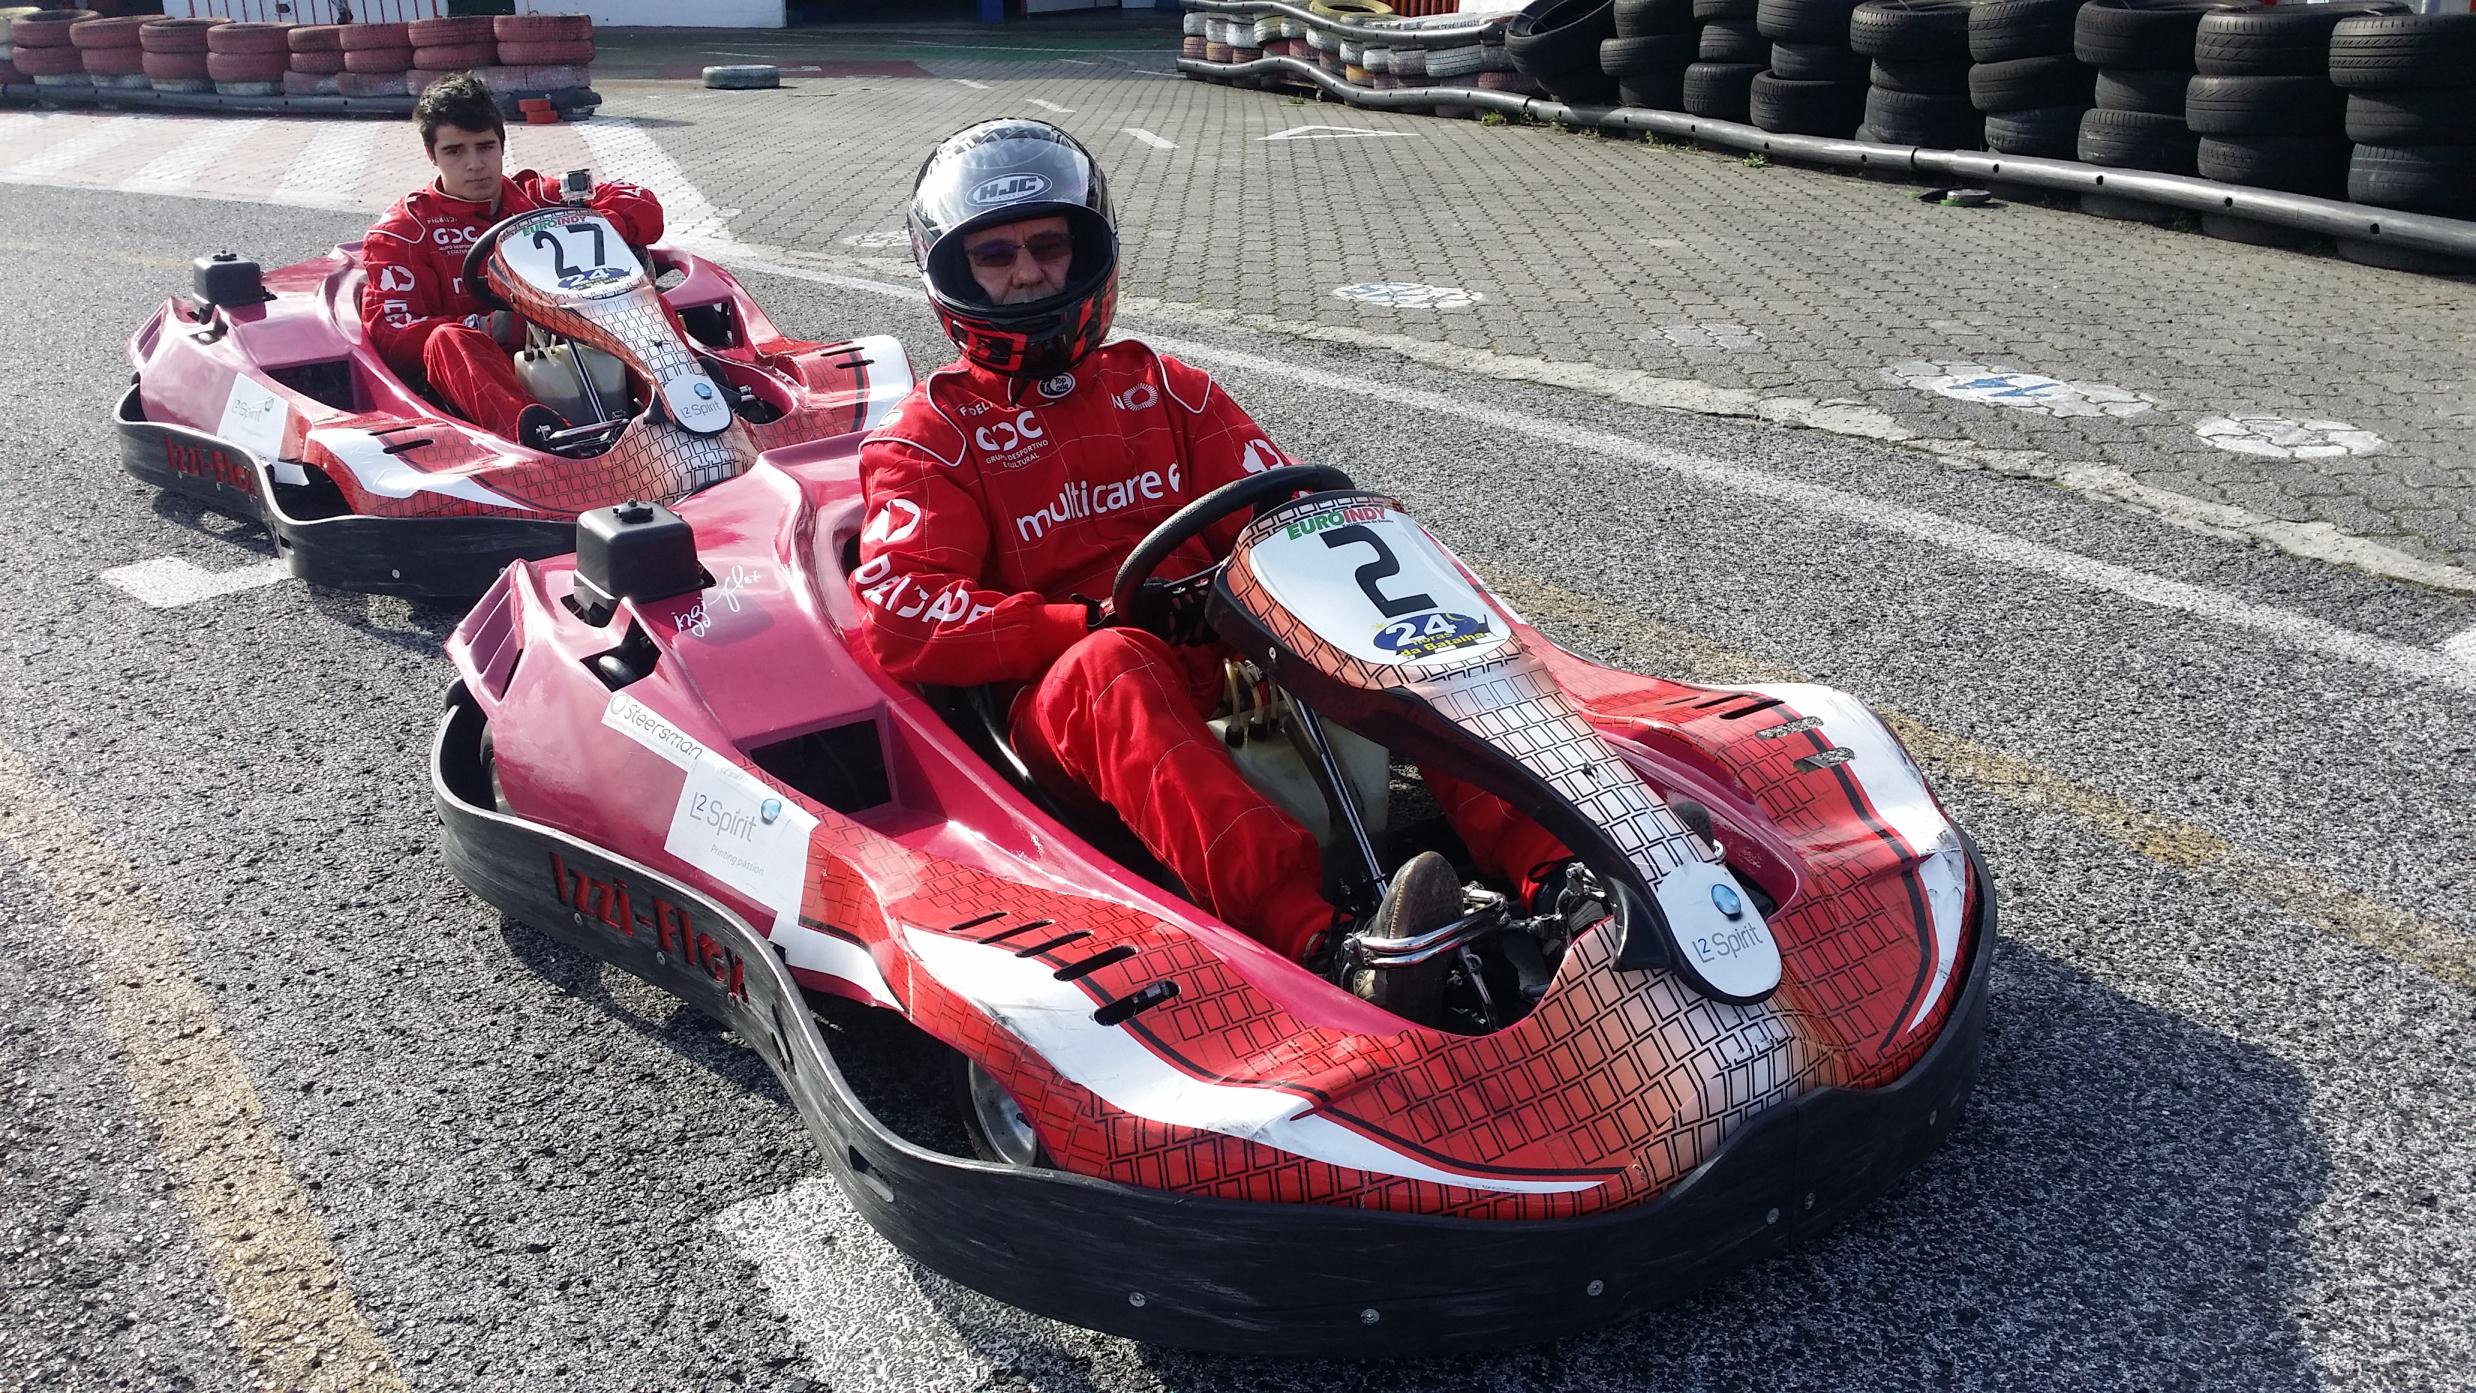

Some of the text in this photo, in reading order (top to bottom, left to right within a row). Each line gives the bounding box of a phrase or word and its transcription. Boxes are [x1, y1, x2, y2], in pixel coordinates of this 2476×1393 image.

[979, 177, 1037, 200] HJC
[523, 216, 587, 236] EUROINDY
[533, 223, 605, 279] 27
[560, 268, 609, 286] 24
[1055, 377, 1067, 385] Top
[691, 401, 723, 418] Spirit
[1007, 439, 1049, 461] DESPORTIVO
[1016, 471, 1164, 541] multicare
[1287, 507, 1385, 541] EUROINDY
[1319, 524, 1438, 619] 2
[1385, 613, 1457, 648] 24
[1400, 631, 1487, 657] da Batalha
[1411, 631, 1453, 646] horas
[623, 703, 703, 760] Steersman
[706, 800, 758, 842] Spirit
[710, 844, 765, 877] Printing passion
[1711, 922, 1764, 959] Spirit
